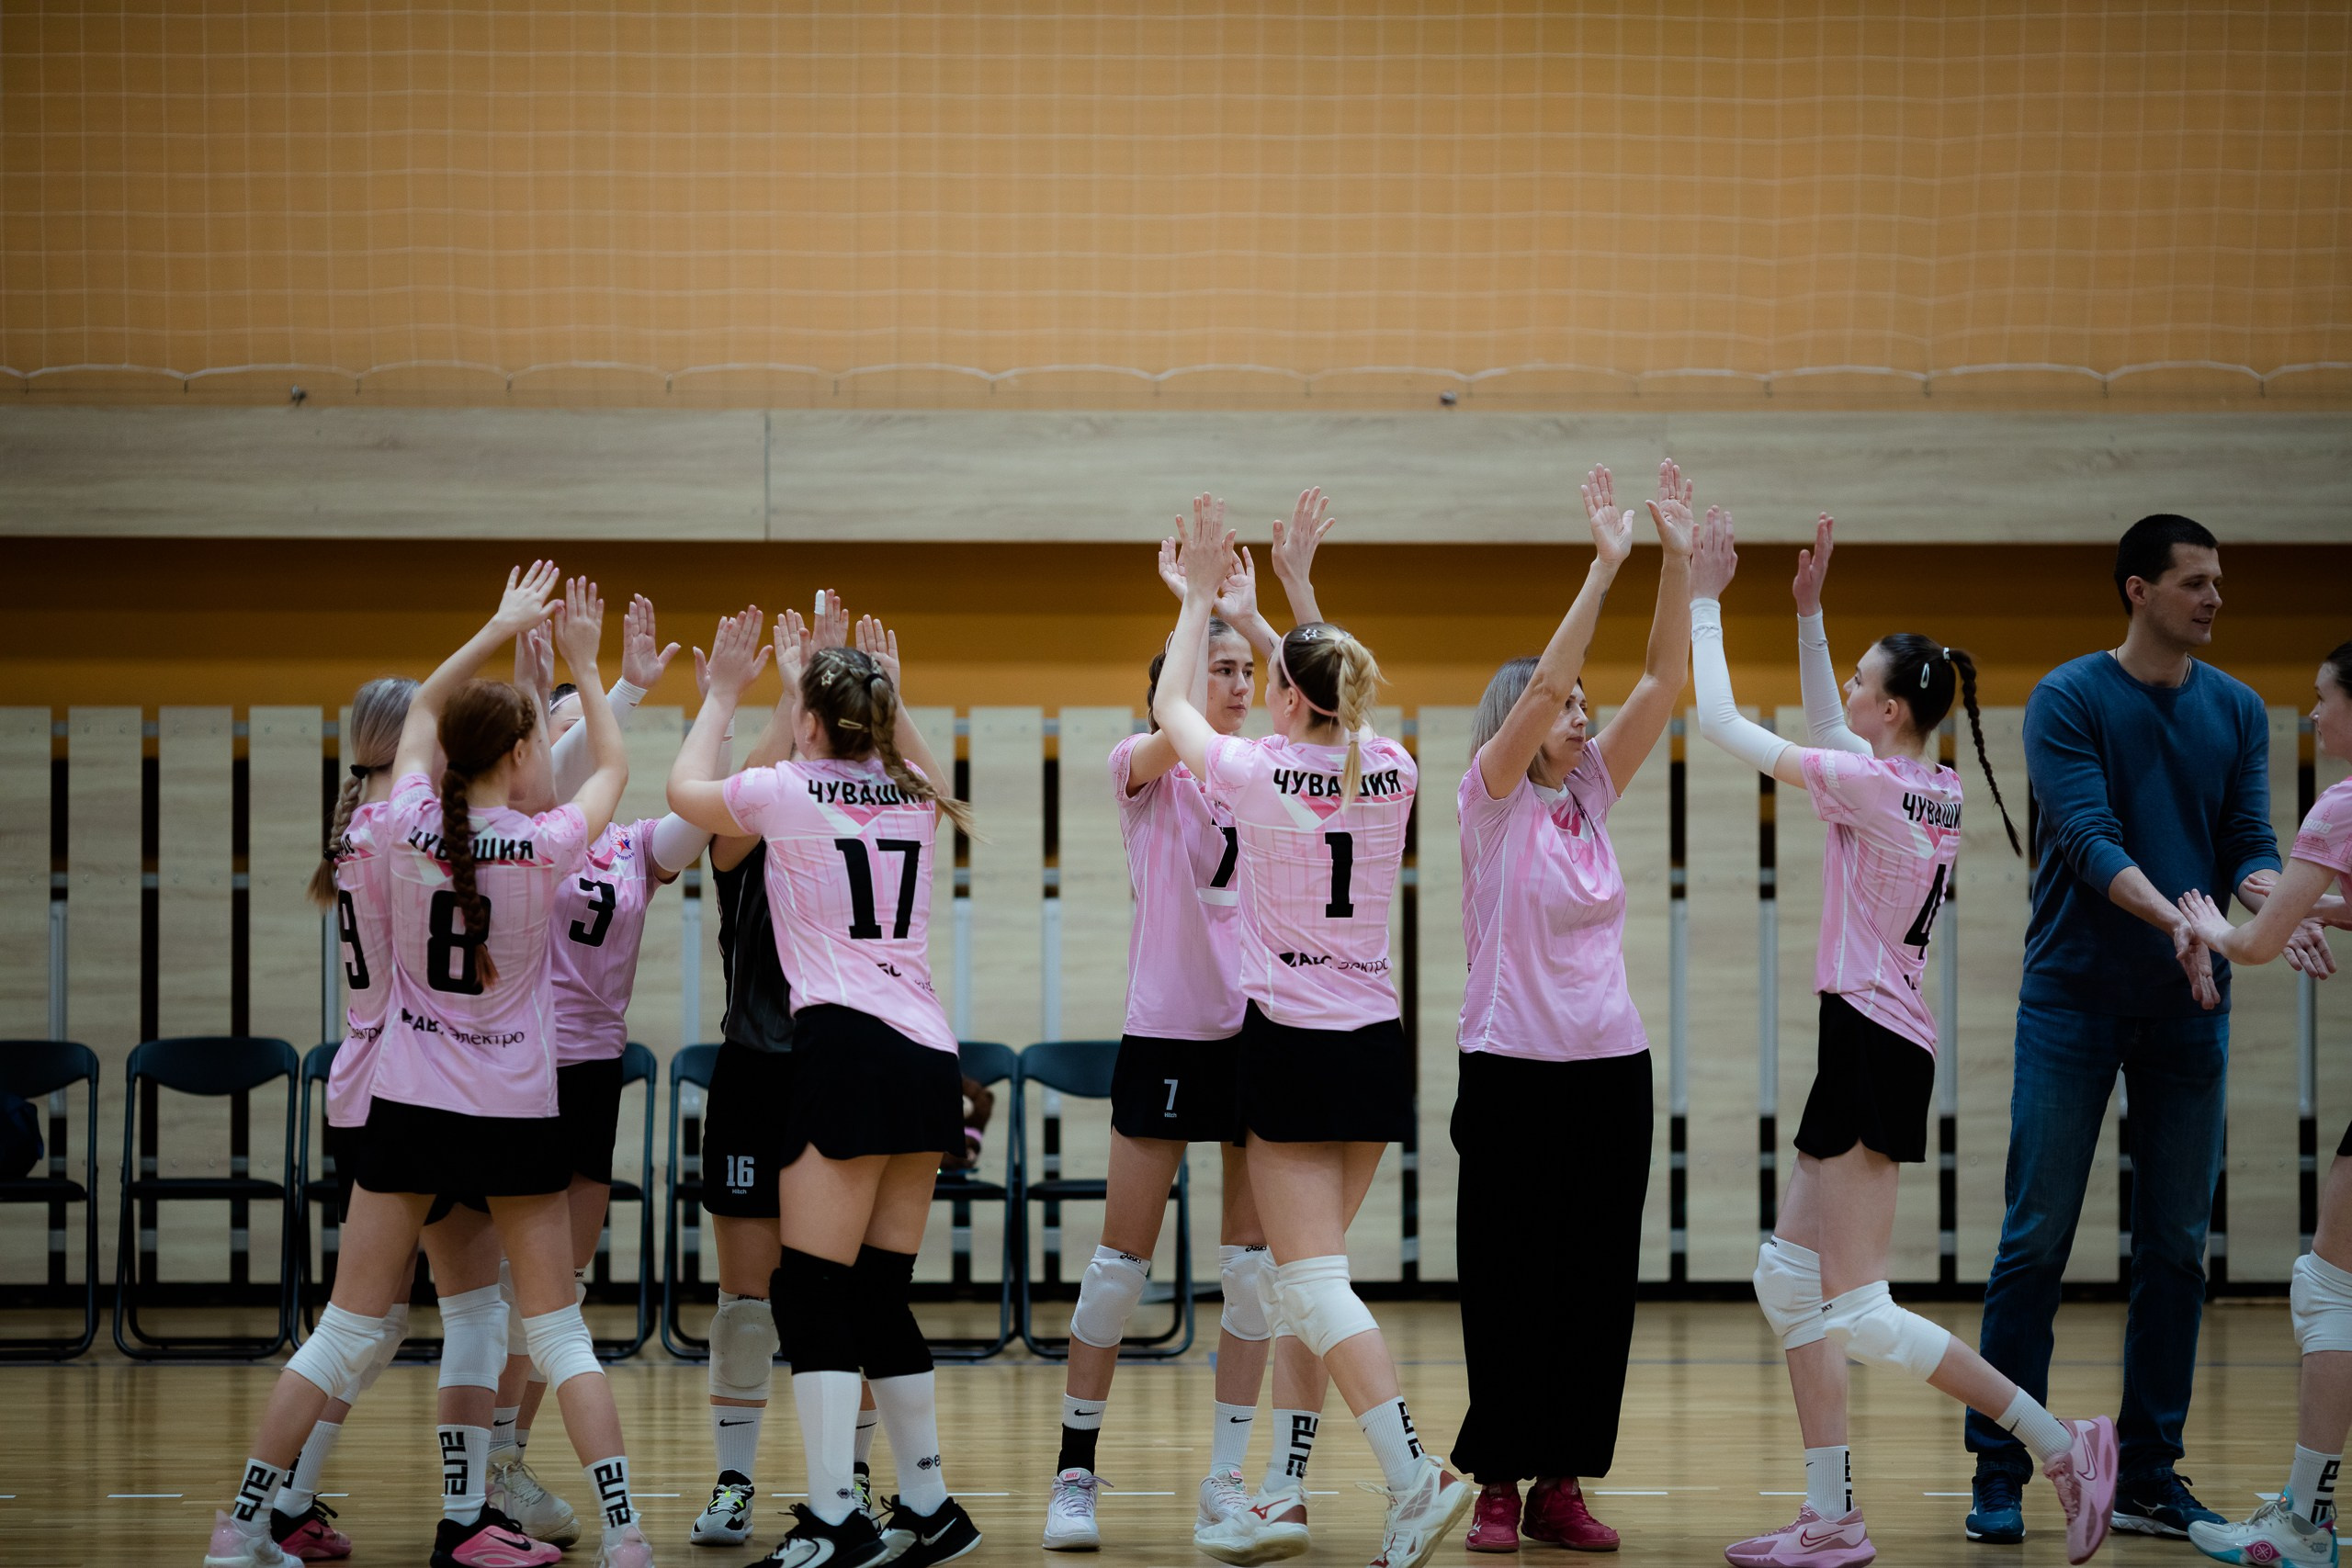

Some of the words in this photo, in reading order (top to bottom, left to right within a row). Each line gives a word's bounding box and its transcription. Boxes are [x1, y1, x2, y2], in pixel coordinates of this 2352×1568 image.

[808, 779, 928, 807] ЧУВАШИ
[1902, 792, 1962, 829] ЧУВАШИ
[408, 826, 535, 861] ЧУВШИЯ
[834, 838, 922, 940] 17
[1324, 831, 1355, 919] 1
[337, 889, 370, 990] 9
[568, 877, 616, 948] 3
[427, 889, 492, 996] 8
[1164, 1079, 1179, 1111] 7
[726, 1155, 755, 1187] 16
